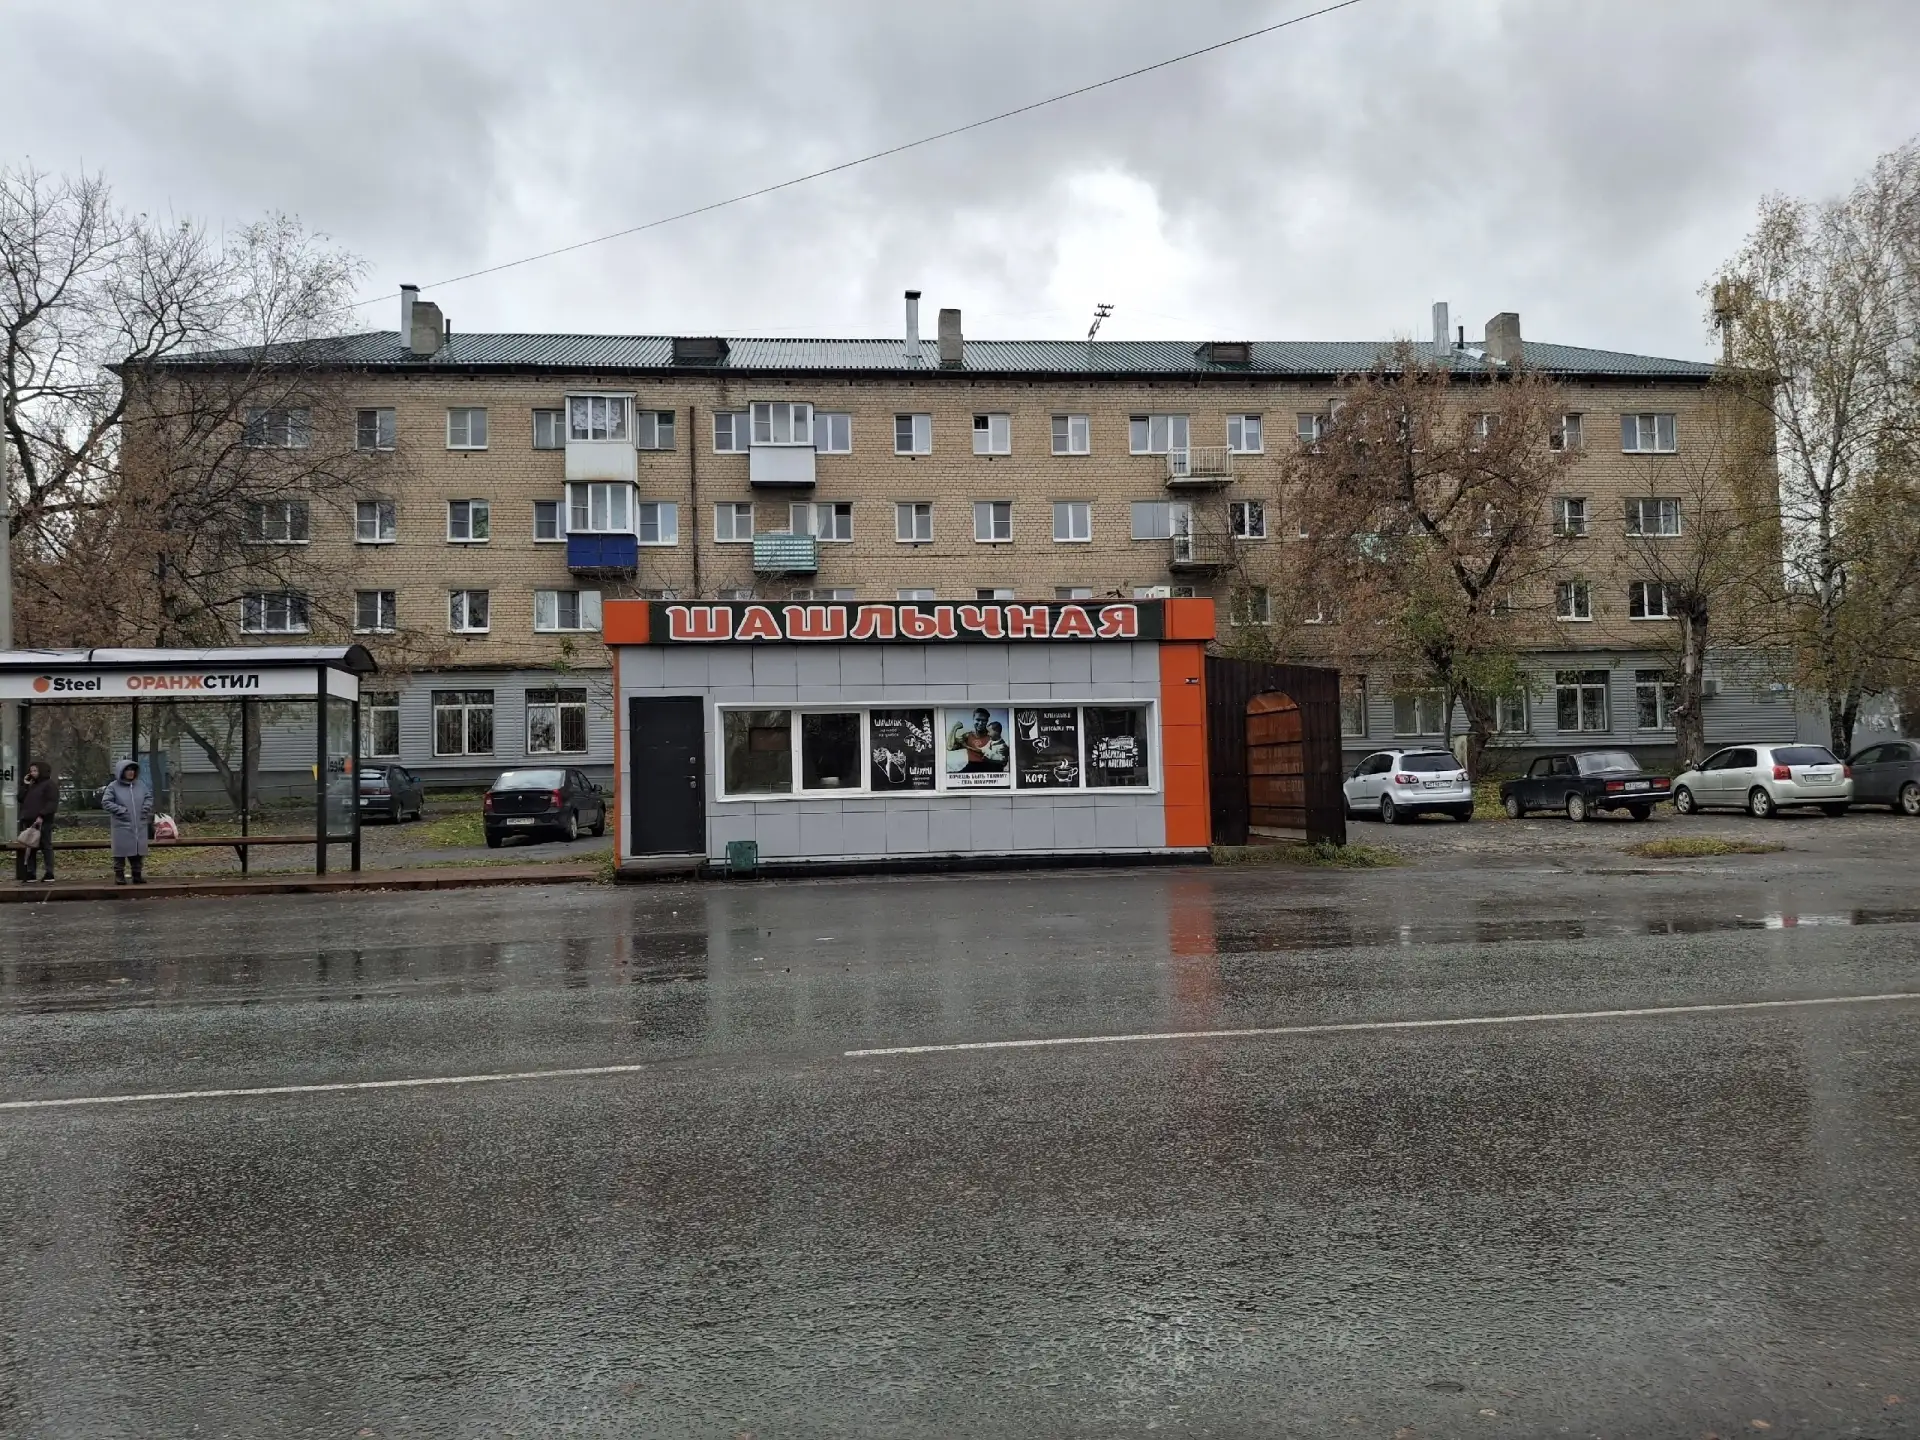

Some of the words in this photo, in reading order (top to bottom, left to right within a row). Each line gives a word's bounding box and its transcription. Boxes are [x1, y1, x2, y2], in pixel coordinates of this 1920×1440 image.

[665, 605, 1139, 640] ШАШЛЫЧНАЯ
[53, 677, 102, 691] Steel
[126, 675, 260, 690] ОРАНЖСТИЛ
[1025, 773, 1048, 783] КОФЕ
